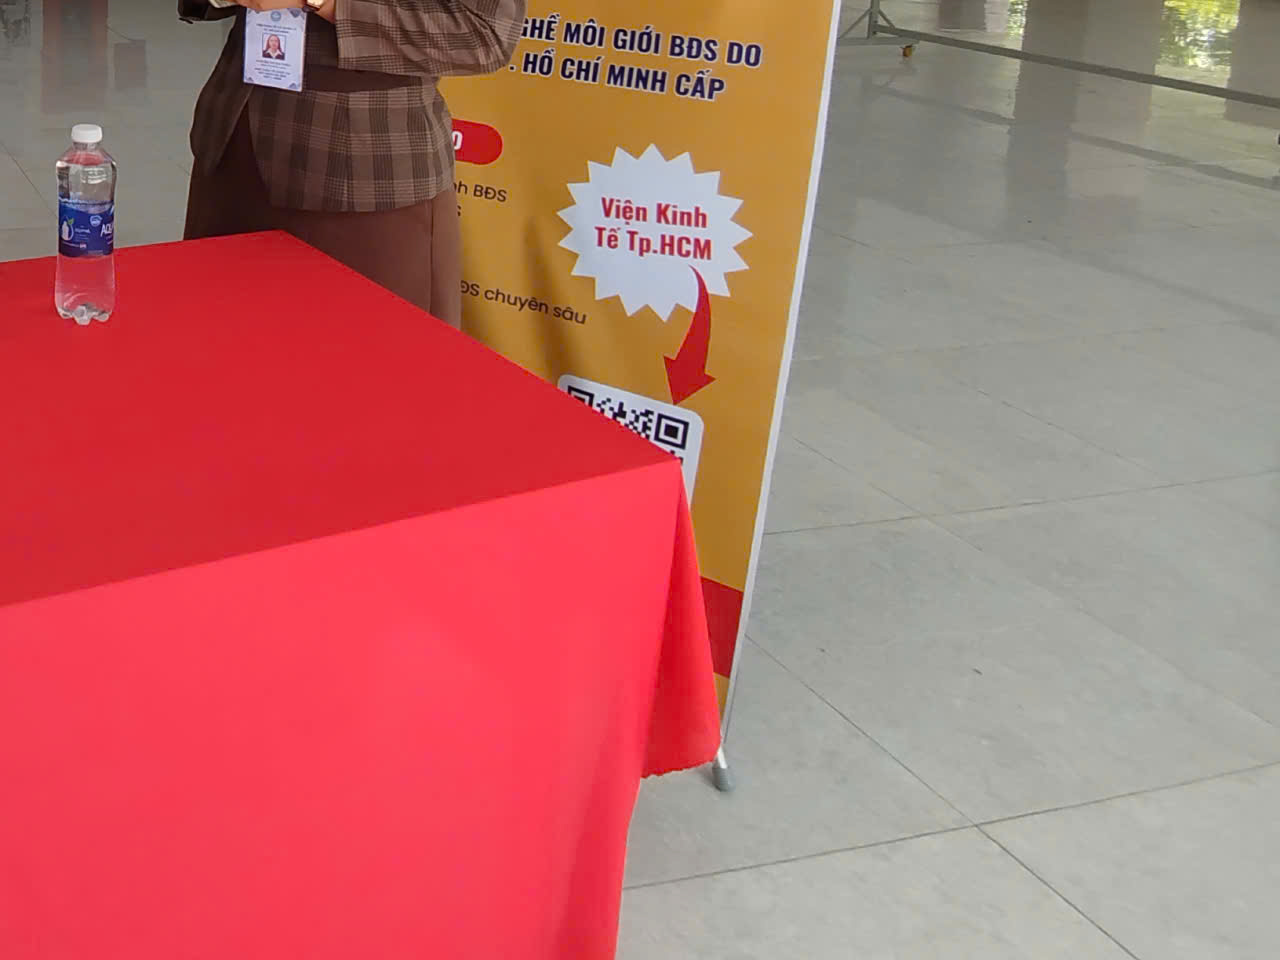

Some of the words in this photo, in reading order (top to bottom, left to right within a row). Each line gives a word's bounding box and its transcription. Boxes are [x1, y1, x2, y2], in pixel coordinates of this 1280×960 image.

[563, 18, 607, 48] MÔI
[613, 25, 662, 56] GIỚI
[669, 35, 720, 63] BĐS
[726, 41, 763, 68] DO
[522, 48, 556, 77] HỒ
[560, 56, 603, 84] CHÍ
[607, 64, 668, 93] MINH
[674, 69, 726, 101] CẤP
[473, 184, 508, 203] BĐS
[601, 197, 648, 225] Viện
[656, 202, 708, 229] Kinh
[594, 226, 621, 250] Tế
[626, 230, 713, 261] Tp.HCM
[460, 280, 480, 297] ĐS
[484, 288, 549, 315] chuyên
[553, 305, 587, 325] sâu
